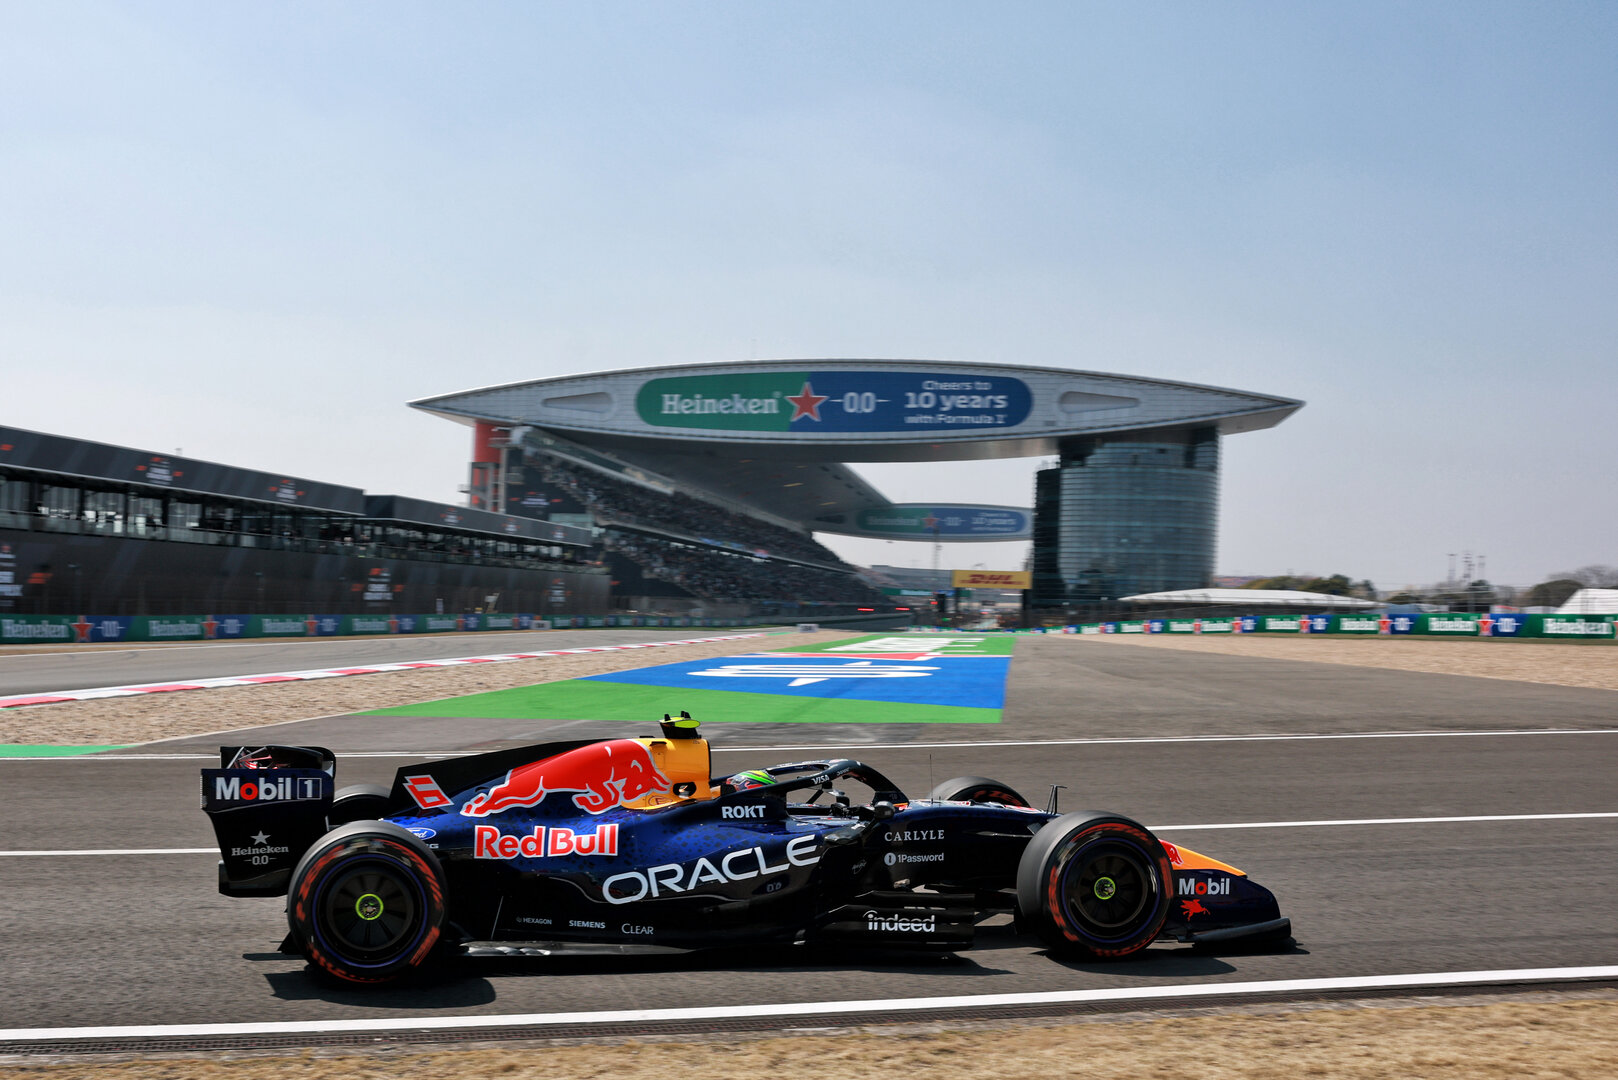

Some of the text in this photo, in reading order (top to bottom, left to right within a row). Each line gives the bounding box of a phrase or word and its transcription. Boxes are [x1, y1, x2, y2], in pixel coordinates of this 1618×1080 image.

[661, 393, 779, 414] Heineken
[904, 392, 1008, 411] 10 years
[812, 774, 830, 785] VISA
[216, 777, 292, 800] Mobil
[721, 805, 766, 819] ROKT
[474, 823, 619, 859] Red Bull
[884, 829, 945, 842] CARLYLE
[231, 845, 289, 857] Heineken
[897, 852, 945, 863] 1Password
[602, 834, 821, 905] ORACLE
[1179, 878, 1230, 895] Mobil
[522, 917, 552, 925] HEXAGON
[569, 920, 606, 929] SIEMENS
[863, 910, 935, 932] indeed
